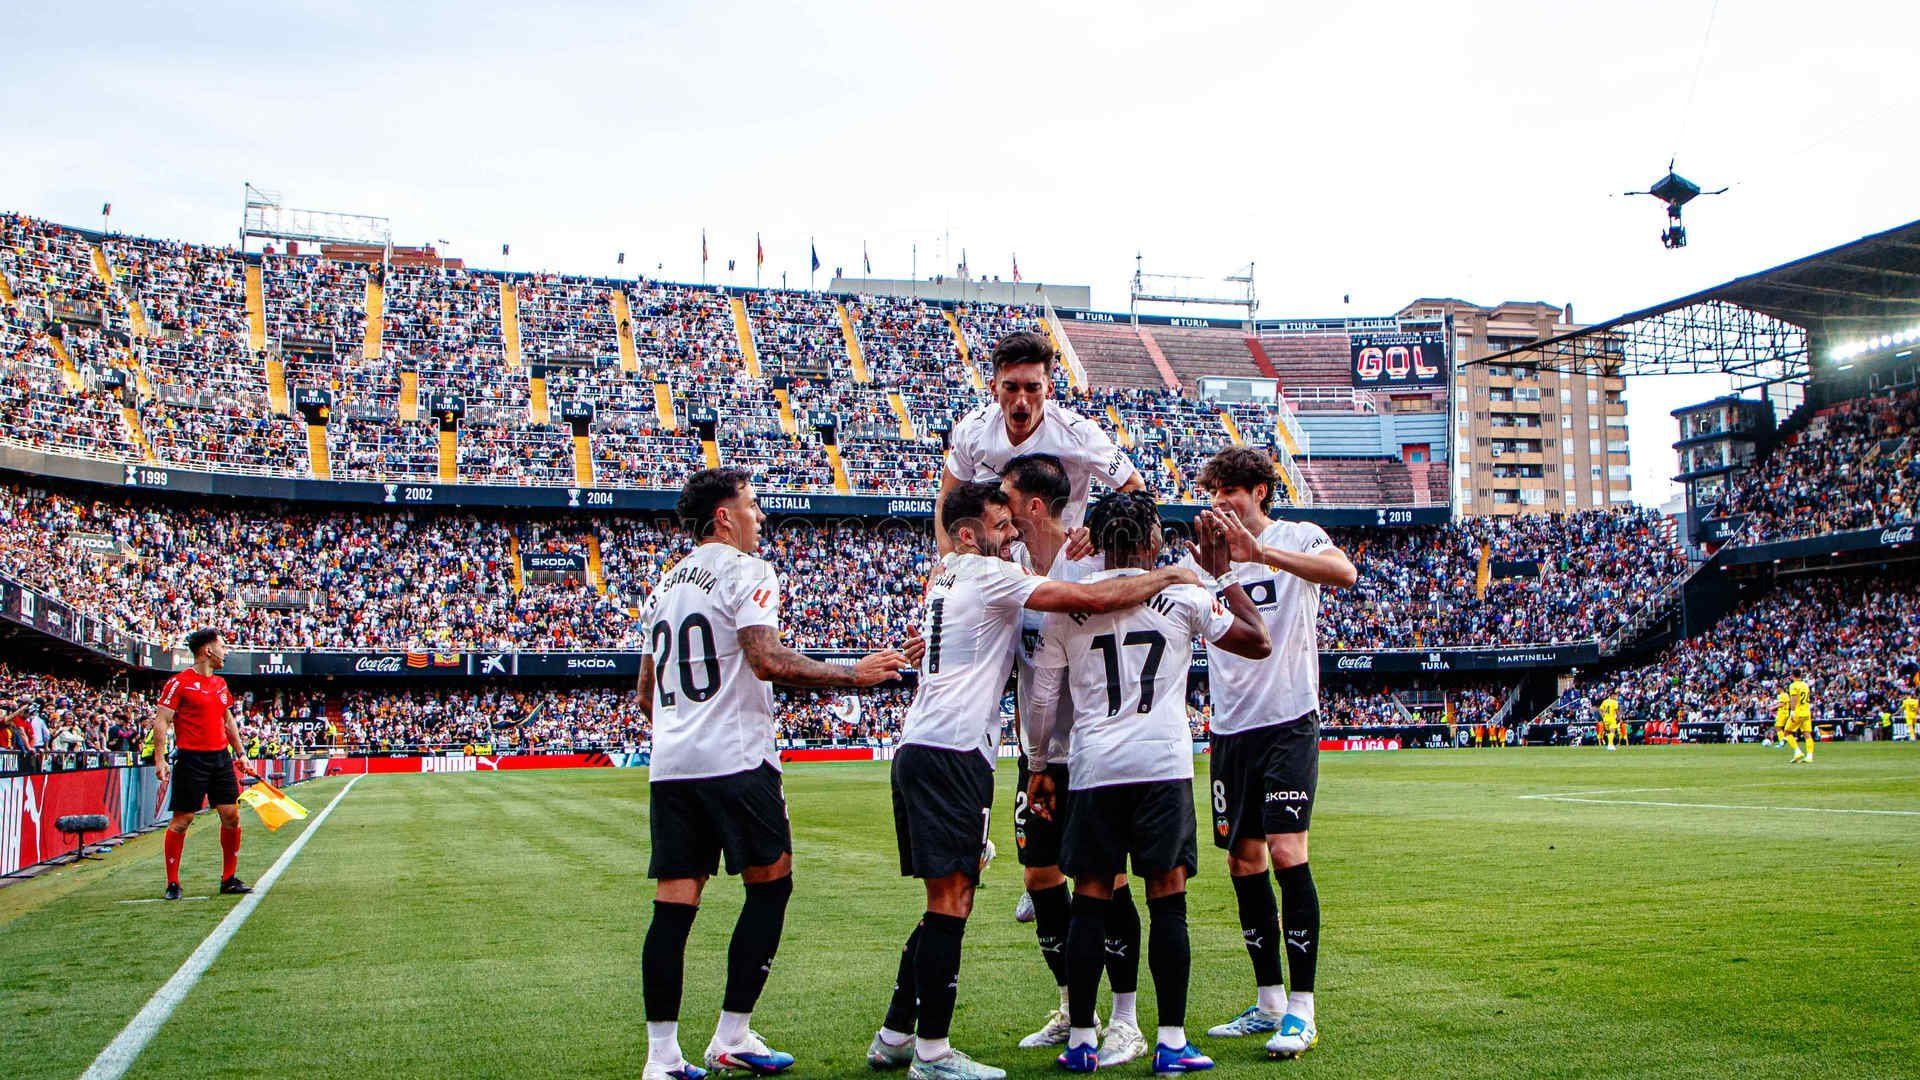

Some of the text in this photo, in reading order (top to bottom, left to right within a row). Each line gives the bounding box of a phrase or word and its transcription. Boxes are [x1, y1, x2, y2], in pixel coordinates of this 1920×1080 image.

[1085, 312, 1114, 323] TURIA
[1180, 317, 1209, 328] TURIA
[1290, 322, 1319, 330] TURIA
[1363, 320, 1396, 328] TURIA
[1357, 346, 1439, 377] GOL
[301, 396, 326, 404] TURIA
[436, 403, 459, 411] TURIA
[566, 407, 588, 416] TURIA
[691, 413, 713, 421] TURIA
[811, 418, 832, 426] TURIA
[928, 422, 948, 431] TURIA
[140, 470, 168, 486] 1999
[405, 487, 433, 501] 2002
[587, 492, 614, 505] 2004
[760, 496, 811, 510] MESTALLA
[888, 500, 932, 514] ¡GRACIAS
[1389, 511, 1412, 523] 2019
[1715, 530, 1735, 539] TURIA
[531, 558, 576, 567] SKODA
[663, 566, 719, 596] SARAVIA
[567, 657, 617, 669] SKODA
[652, 612, 722, 708] 20
[1498, 653, 1556, 663] MARTINELLI
[258, 664, 294, 675] TURIA
[1420, 662, 1450, 670] TURIA
[1089, 629, 1167, 718] 17
[1343, 740, 1385, 751] LALIGA
[1424, 741, 1450, 749] TURIA
[421, 756, 477, 773] PUMA
[1213, 780, 1227, 814] 8
